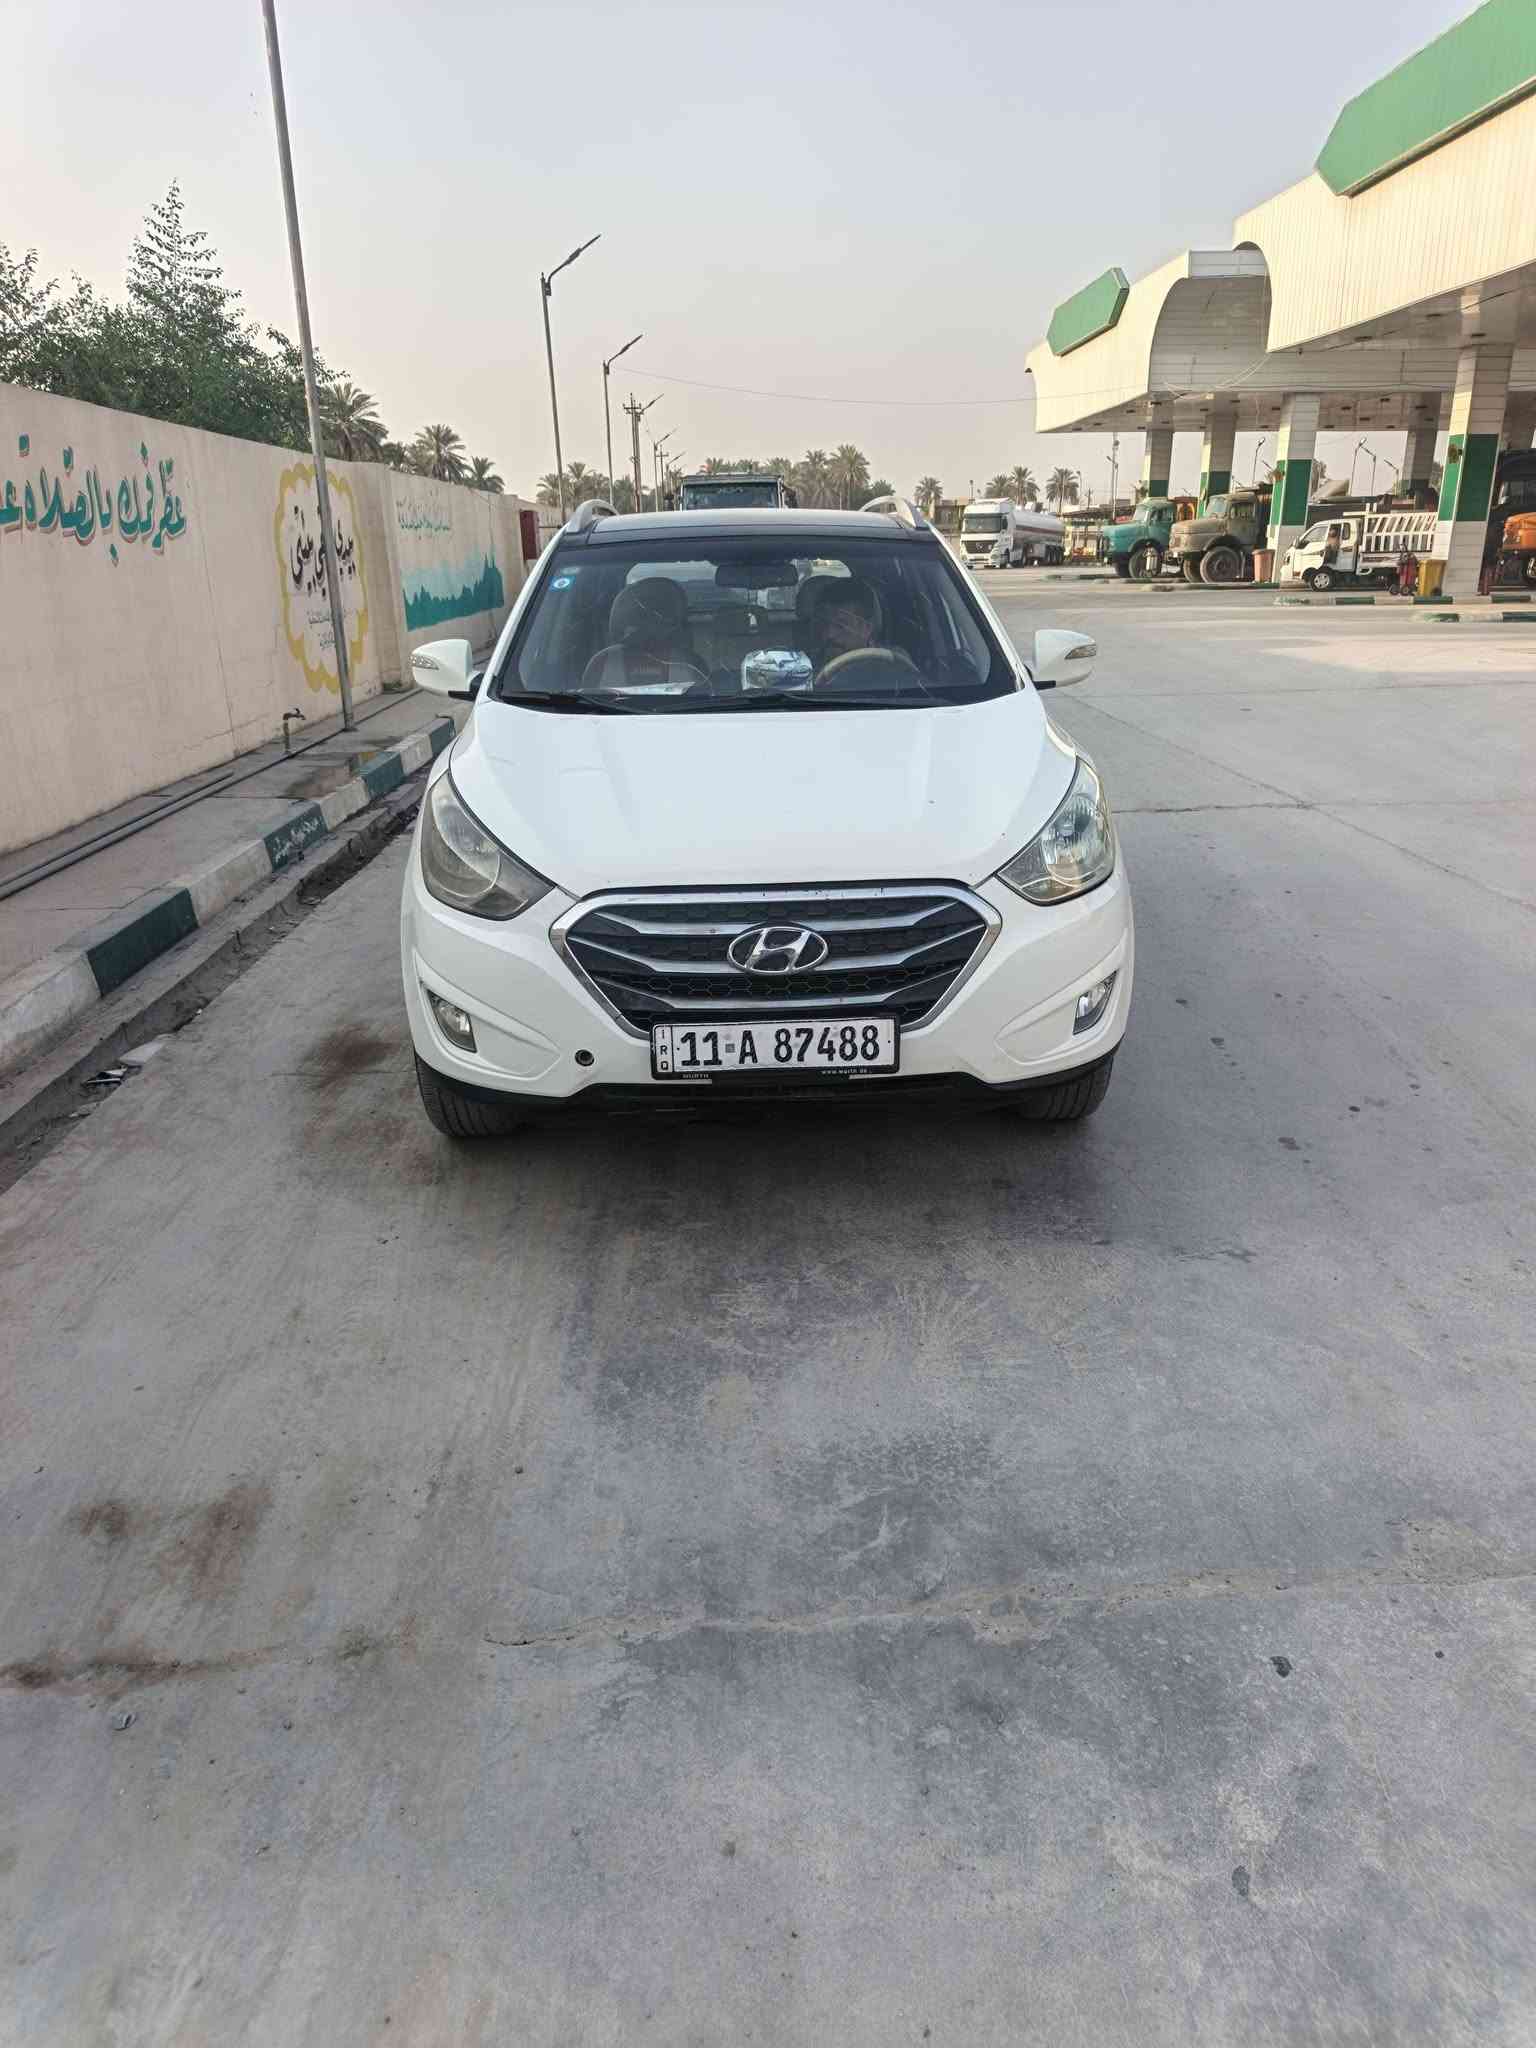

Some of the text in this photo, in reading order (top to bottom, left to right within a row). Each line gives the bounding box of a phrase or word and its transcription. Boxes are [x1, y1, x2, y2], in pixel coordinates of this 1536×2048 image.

[680, 1025, 880, 1066] 11 A 87488
